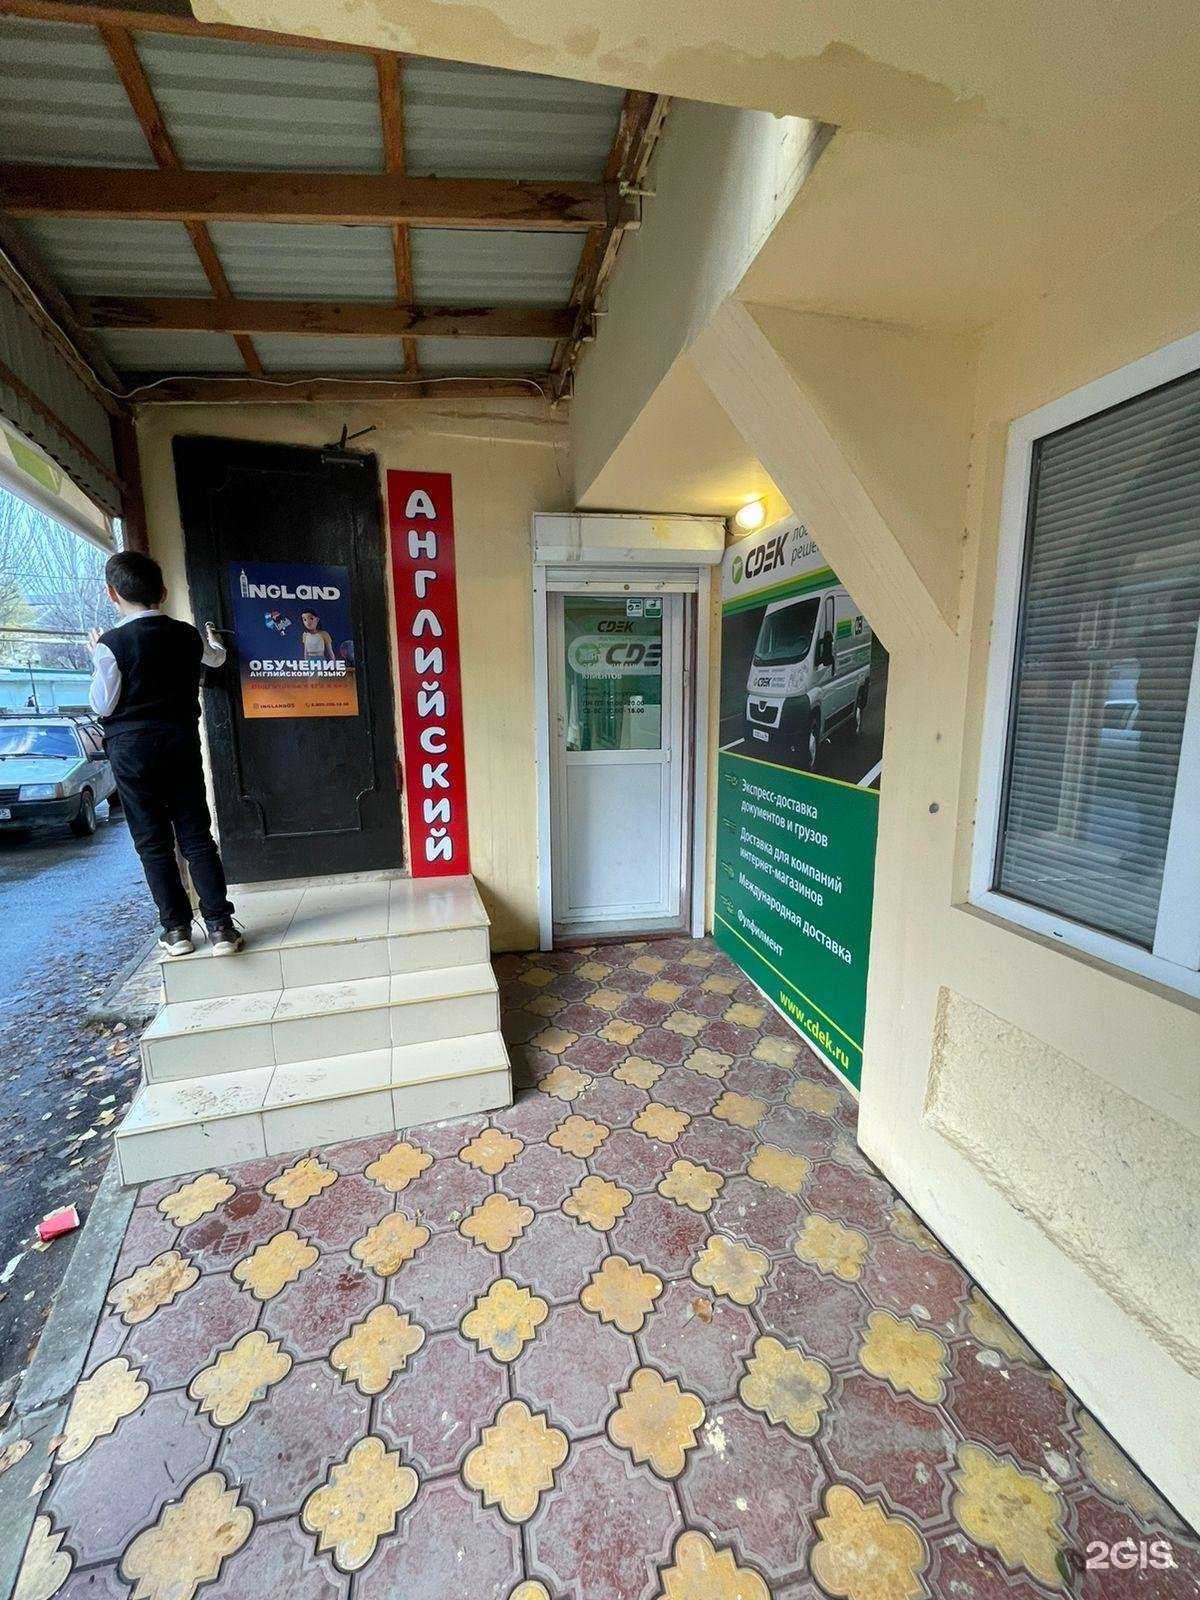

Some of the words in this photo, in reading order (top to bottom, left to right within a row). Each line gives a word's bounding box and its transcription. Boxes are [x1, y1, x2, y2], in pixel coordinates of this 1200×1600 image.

[745, 532, 789, 579] CDEK
[791, 542, 819, 567] реше
[597, 621, 634, 633] CDEK
[249, 660, 346, 671] ОБУЧЕНИЕ
[405, 489, 453, 862] АНГЛИЙСКИЙ
[606, 643, 662, 666] CDE
[742, 779, 817, 819] Экспресс-доставка
[741, 800, 786, 828] документов
[787, 820, 793, 832] и
[794, 822, 828, 847] грузов
[740, 827, 773, 855] Доставка
[773, 848, 789, 864] для
[791, 856, 842, 894] компаний
[740, 847, 823, 907] интернет-магазинов
[737, 909, 783, 956] Фулфилмент
[739, 872, 802, 927] Международная
[803, 921, 852, 964] доставка
[780, 990, 849, 1069] www.cdek.ru
